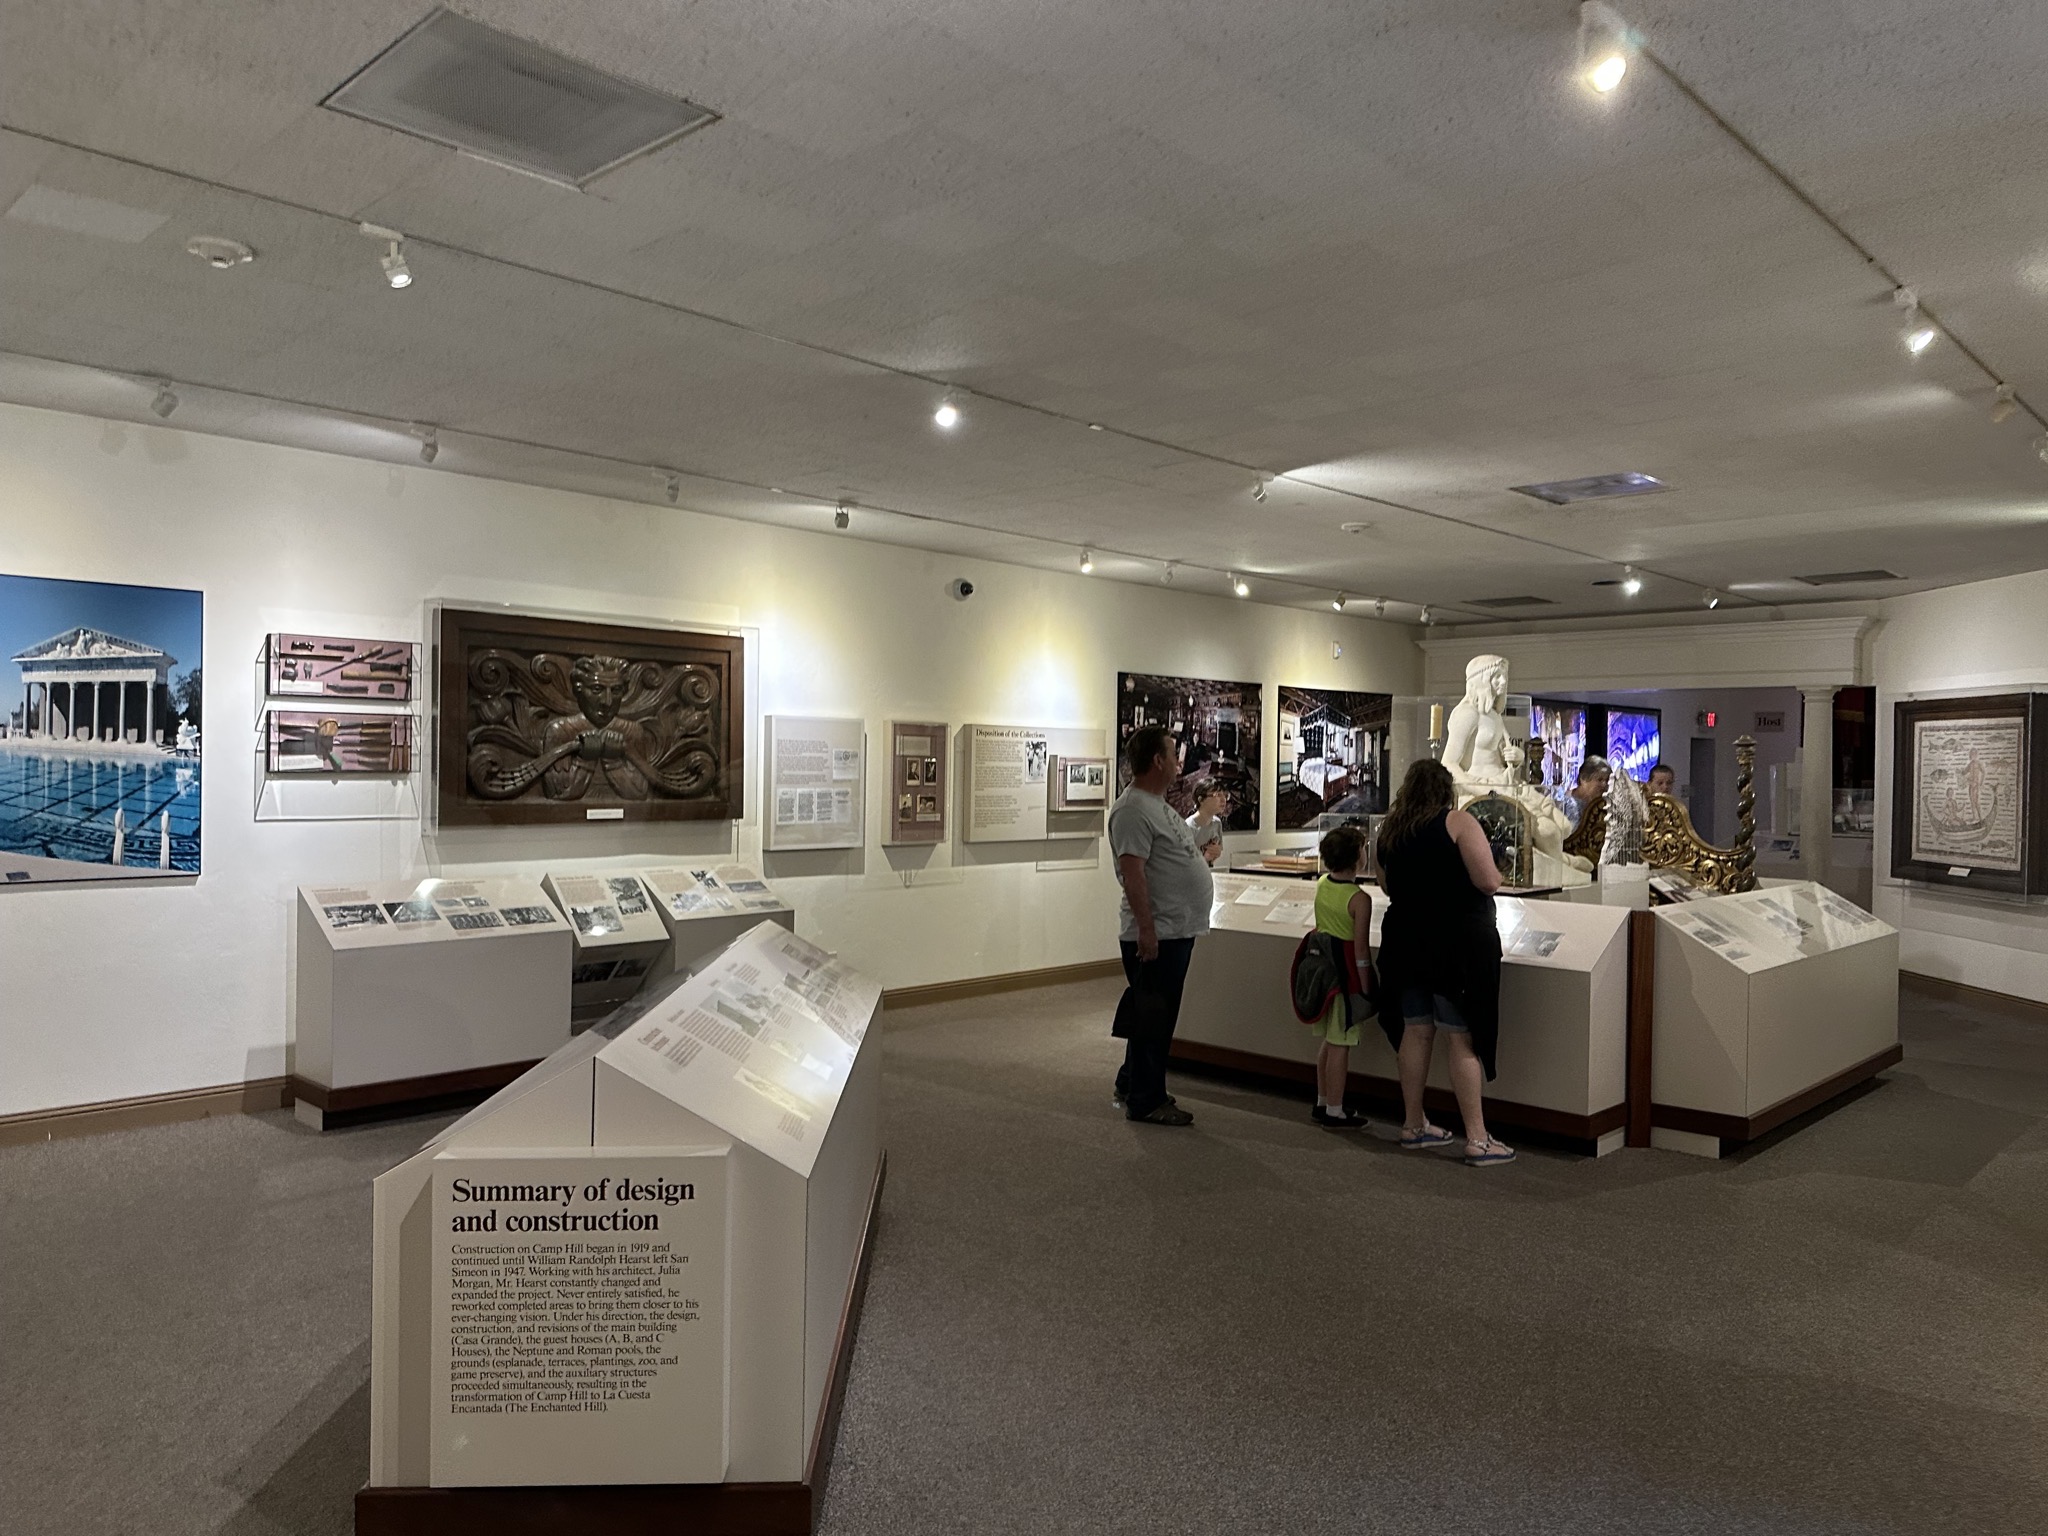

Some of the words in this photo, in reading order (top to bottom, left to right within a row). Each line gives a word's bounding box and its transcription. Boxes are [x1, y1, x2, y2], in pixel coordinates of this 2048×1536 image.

[1758, 717, 1781, 727] Host
[976, 728, 1004, 738] Disposition
[1004, 730, 1010, 738] of
[1011, 730, 1019, 738] the
[1020, 730, 1046, 739] Collections
[452, 1178, 576, 1206] Summary
[583, 1178, 610, 1202] of
[616, 1177, 695, 1206] design
[452, 1209, 498, 1232] and
[505, 1208, 660, 1232] construction
[451, 1244, 515, 1254] Construction
[517, 1246, 531, 1254] on
[532, 1243, 563, 1256] Camp
[565, 1243, 584, 1253] Hill
[586, 1243, 615, 1255] began
[616, 1242, 628, 1253] in
[630, 1242, 650, 1253] 1919
[651, 1242, 670, 1252] and
[451, 1255, 500, 1265] continued
[502, 1255, 525, 1265] until
[528, 1254, 566, 1265] William
[568, 1254, 617, 1267] Randolph
[619, 1253, 650, 1264] Hearst
[652, 1253, 668, 1263] left
[670, 1253, 689, 1263] San
[451, 1266, 489, 1277] Simeon
[490, 1266, 501, 1277] in
[529, 1266, 570, 1279] Working
[572, 1265, 594, 1276] with
[595, 1265, 611, 1275] his
[657, 1265, 681, 1275] Julia
[516, 1277, 547, 1288] Hearst
[549, 1277, 599, 1290] constantly
[600, 1276, 641, 1289] changed
[642, 1276, 661, 1286] and
[451, 1289, 498, 1302] expanded
[499, 1289, 516, 1299] the
[556, 1288, 584, 1299] Never
[586, 1288, 622, 1301] entirely
[667, 1287, 680, 1298] he
[451, 1301, 496, 1312] reworked
[497, 1300, 547, 1314] completed
[576, 1301, 587, 1310] to
[588, 1300, 614, 1313] bring
[615, 1299, 641, 1310] them
[642, 1299, 670, 1309] closer
[672, 1300, 683, 1309] to
[685, 1299, 700, 1309] his
[451, 1312, 518, 1325] ever-changing
[553, 1311, 584, 1322] Under
[585, 1311, 600, 1321] his
[649, 1310, 665, 1321] the
[516, 1323, 536, 1333] and
[537, 1322, 580, 1333] revisions
[580, 1322, 591, 1332] of
[593, 1322, 609, 1332] the
[610, 1322, 636, 1332] main
[637, 1321, 677, 1334] building
[451, 1335, 479, 1347] (Casa
[525, 1334, 542, 1344] the
[543, 1335, 568, 1347] guest
[570, 1333, 604, 1344] houses
[635, 1333, 654, 1343] and
[655, 1333, 665, 1343] C
[494, 1346, 511, 1356] the
[512, 1345, 554, 1358] Neptune
[556, 1345, 575, 1355] and
[577, 1345, 613, 1355] Roman
[645, 1344, 661, 1354] the
[451, 1357, 491, 1370] grounds
[660, 1355, 678, 1365] and
[450, 1372, 478, 1382] game
[527, 1368, 546, 1378] and
[548, 1368, 564, 1378] the
[609, 1368, 657, 1377] structures
[451, 1380, 500, 1393] proceeded
[576, 1378, 618, 1392] resulting
[619, 1378, 630, 1388] in
[631, 1378, 647, 1388] the
[451, 1391, 523, 1402] transformation
[524, 1391, 535, 1401] of
[536, 1391, 567, 1404] Camp
[569, 1390, 588, 1401] Hill
[590, 1392, 601, 1400] to
[602, 1390, 616, 1400] La
[617, 1389, 651, 1400] Cuesta
[451, 1403, 503, 1414] Encantada
[504, 1403, 528, 1415] (The
[530, 1402, 582, 1413] Enchanted
